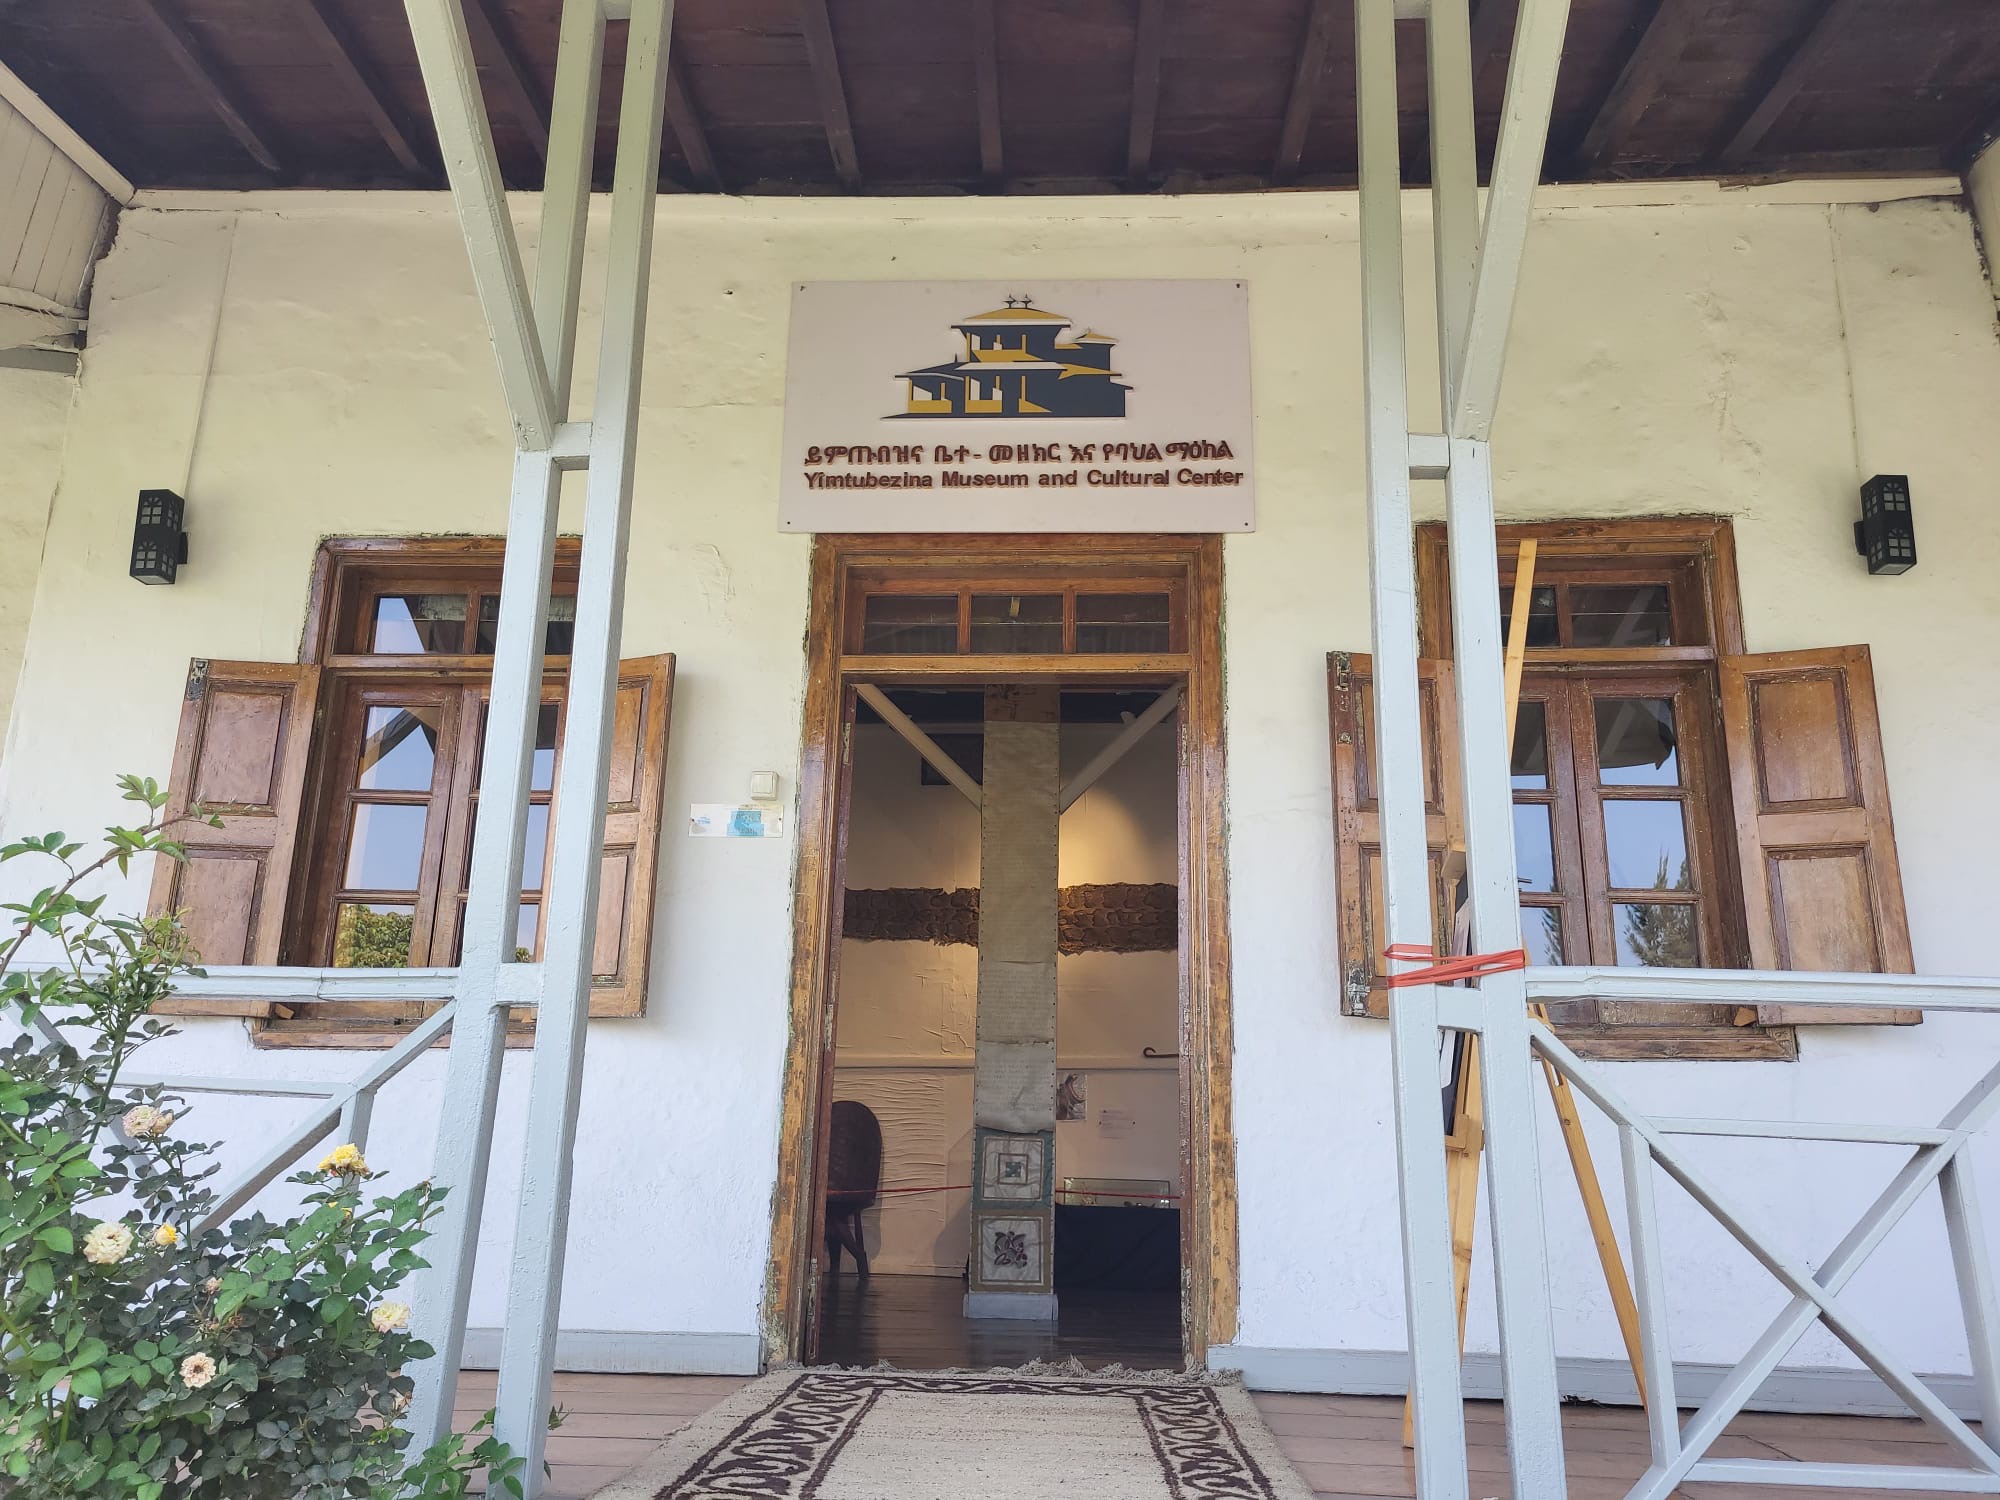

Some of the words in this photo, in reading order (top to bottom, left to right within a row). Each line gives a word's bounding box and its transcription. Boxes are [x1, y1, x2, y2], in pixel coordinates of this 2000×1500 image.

[1068, 443, 1097, 463] እና
[1102, 442, 1163, 463] የባህል
[804, 471, 933, 489] Yimtubezina
[942, 470, 1029, 488] Museum
[1038, 469, 1078, 487] and
[1086, 469, 1170, 487] Cultural
[1176, 468, 1244, 486] Center
